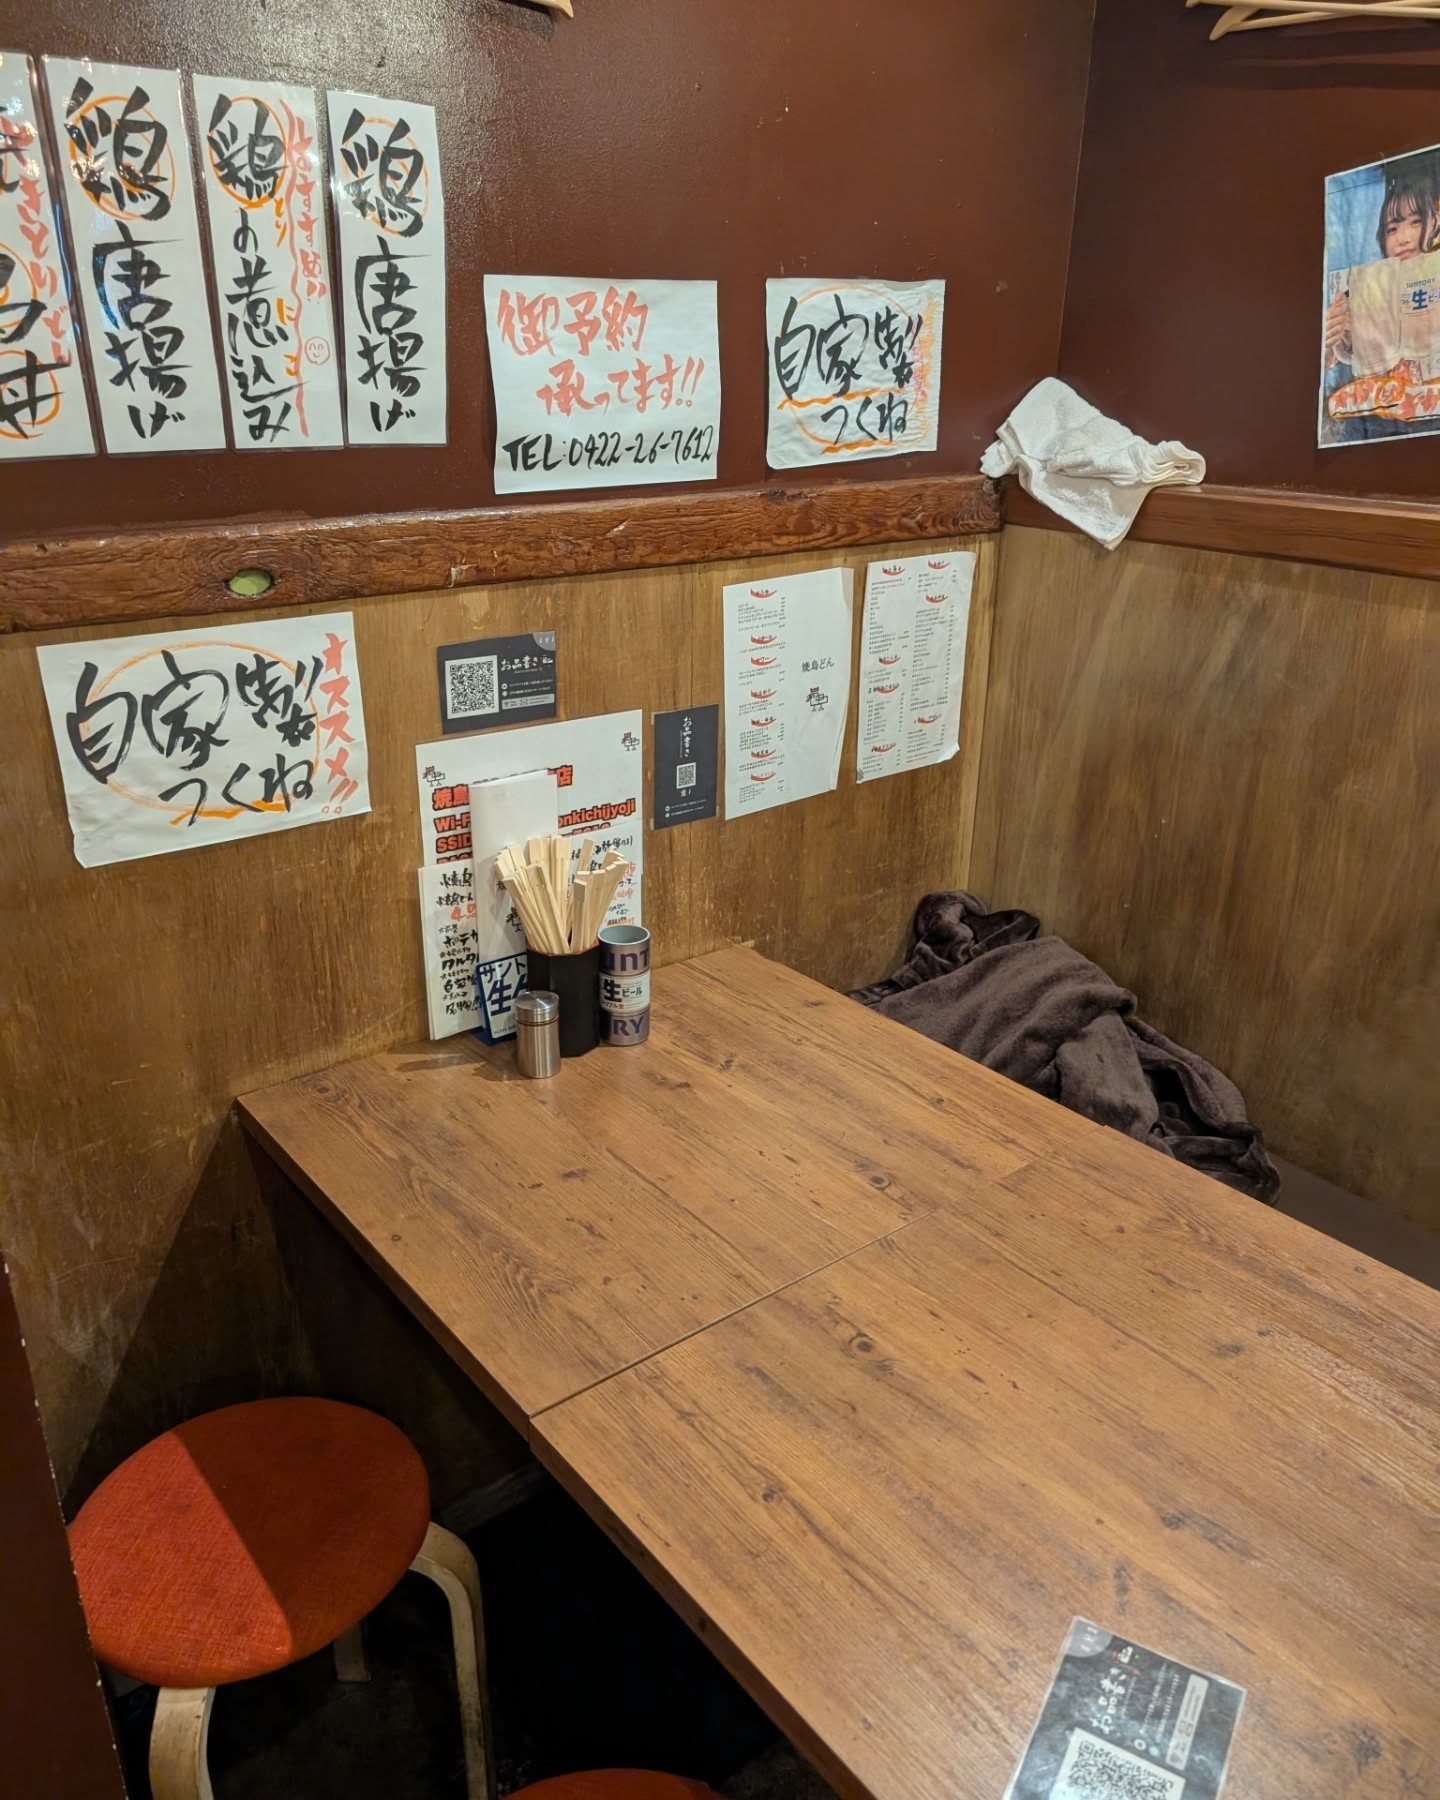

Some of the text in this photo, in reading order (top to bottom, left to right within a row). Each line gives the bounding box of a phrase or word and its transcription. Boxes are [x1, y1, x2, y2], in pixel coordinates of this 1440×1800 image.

[497, 286, 649, 357] 御予約
[820, 397, 908, 444] つくね
[158, 753, 314, 828] つくね
[433, 811, 470, 833] Wi-F
[480, 957, 527, 984] サント
